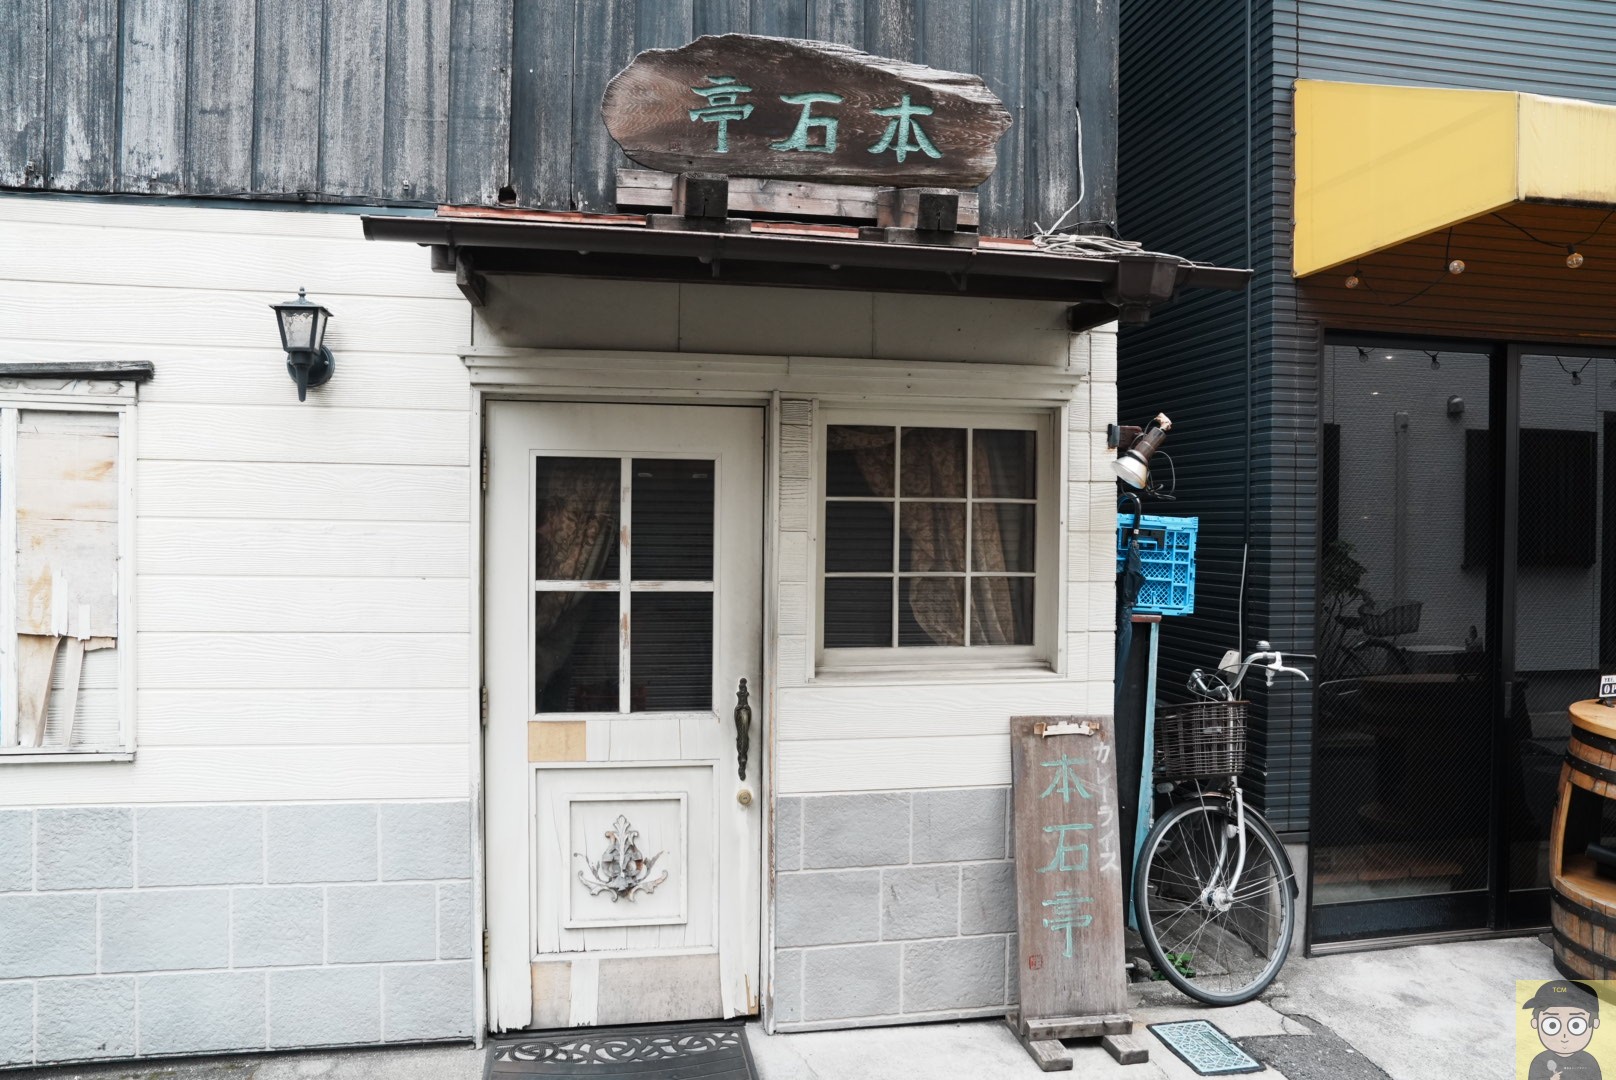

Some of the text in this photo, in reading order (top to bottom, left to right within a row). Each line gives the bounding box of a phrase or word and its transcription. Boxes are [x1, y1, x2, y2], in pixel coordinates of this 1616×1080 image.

[1034, 753, 1095, 958] 本石亭
[1093, 741, 1119, 871] カレーライス
